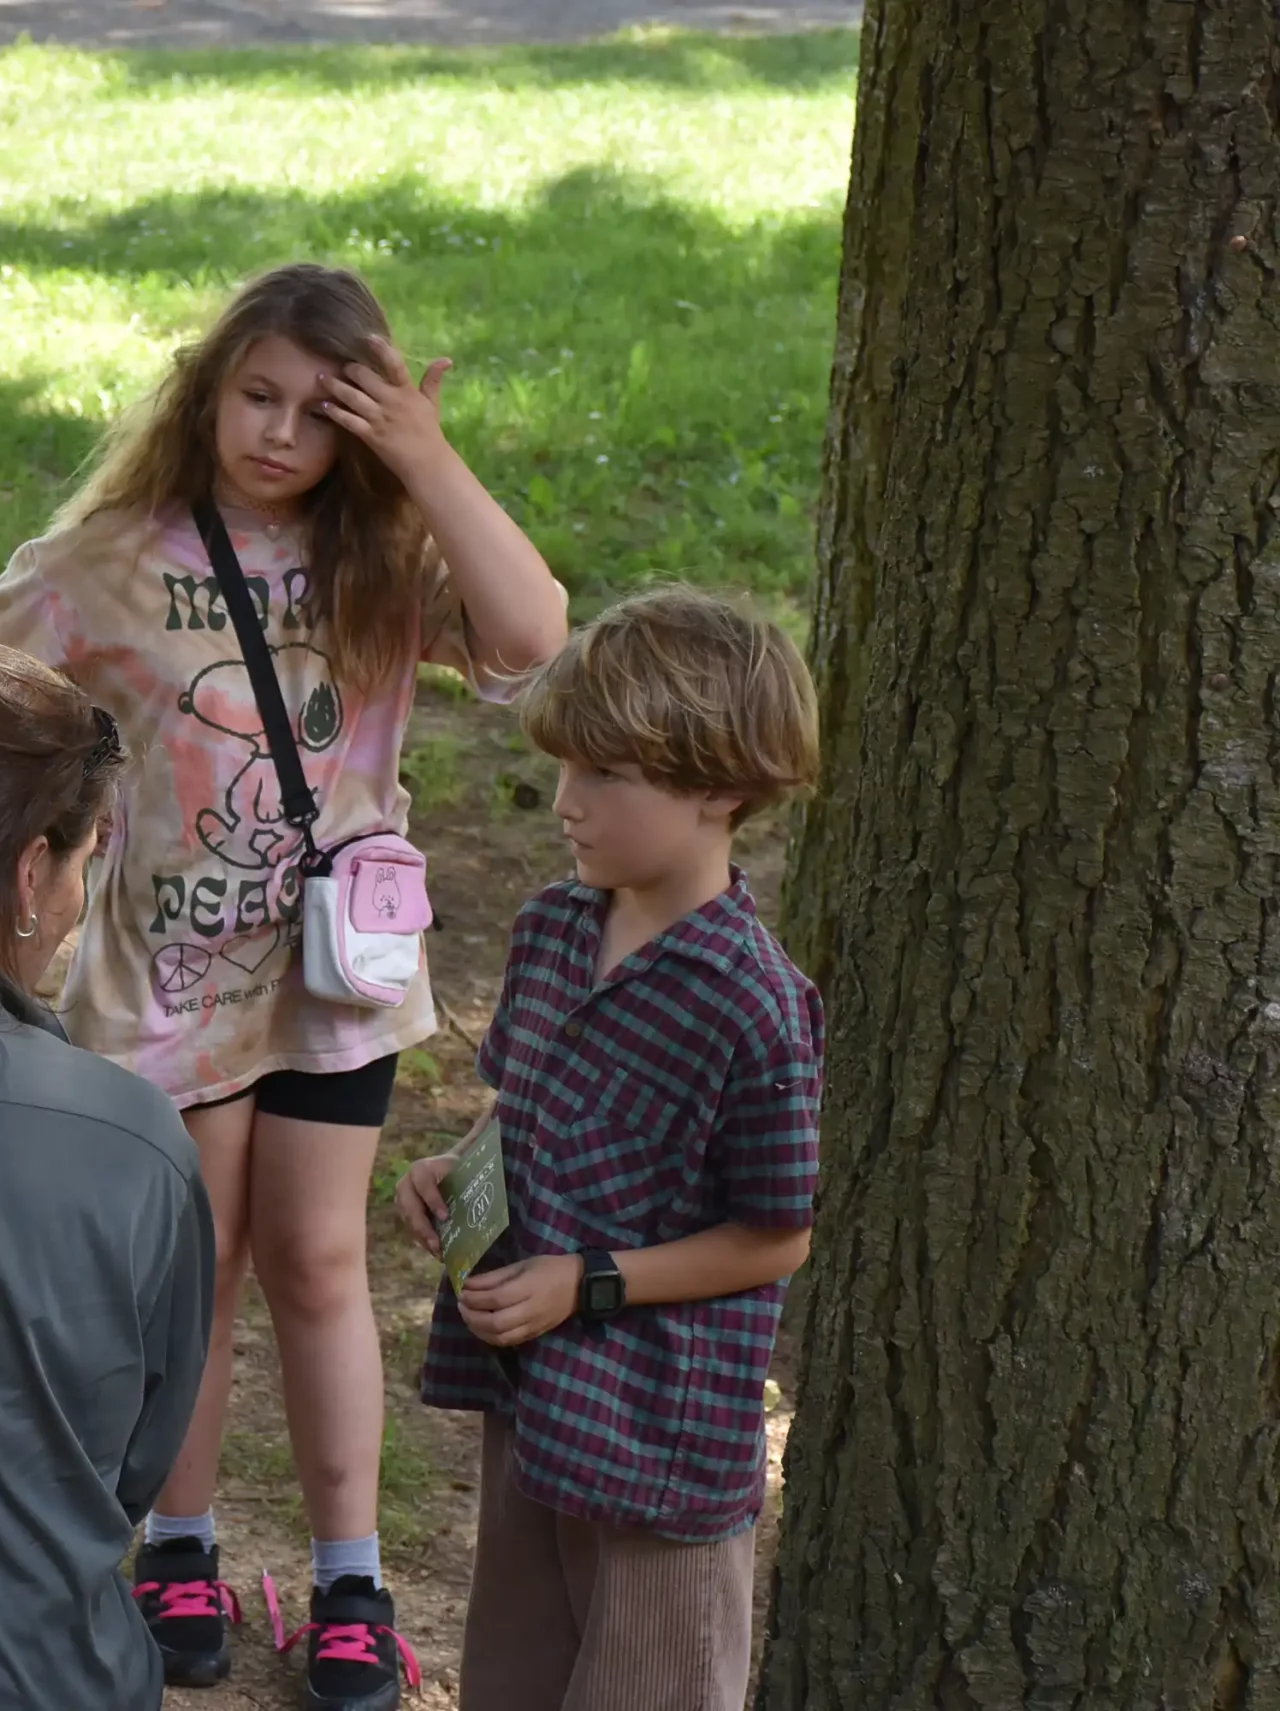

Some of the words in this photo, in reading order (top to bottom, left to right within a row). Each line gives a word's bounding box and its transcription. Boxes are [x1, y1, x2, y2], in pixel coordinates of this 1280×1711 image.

[162, 566, 314, 631] MR
[148, 866, 302, 938] PEAC
[162, 997, 200, 1018] TAKE
[201, 989, 242, 1009] CARE
